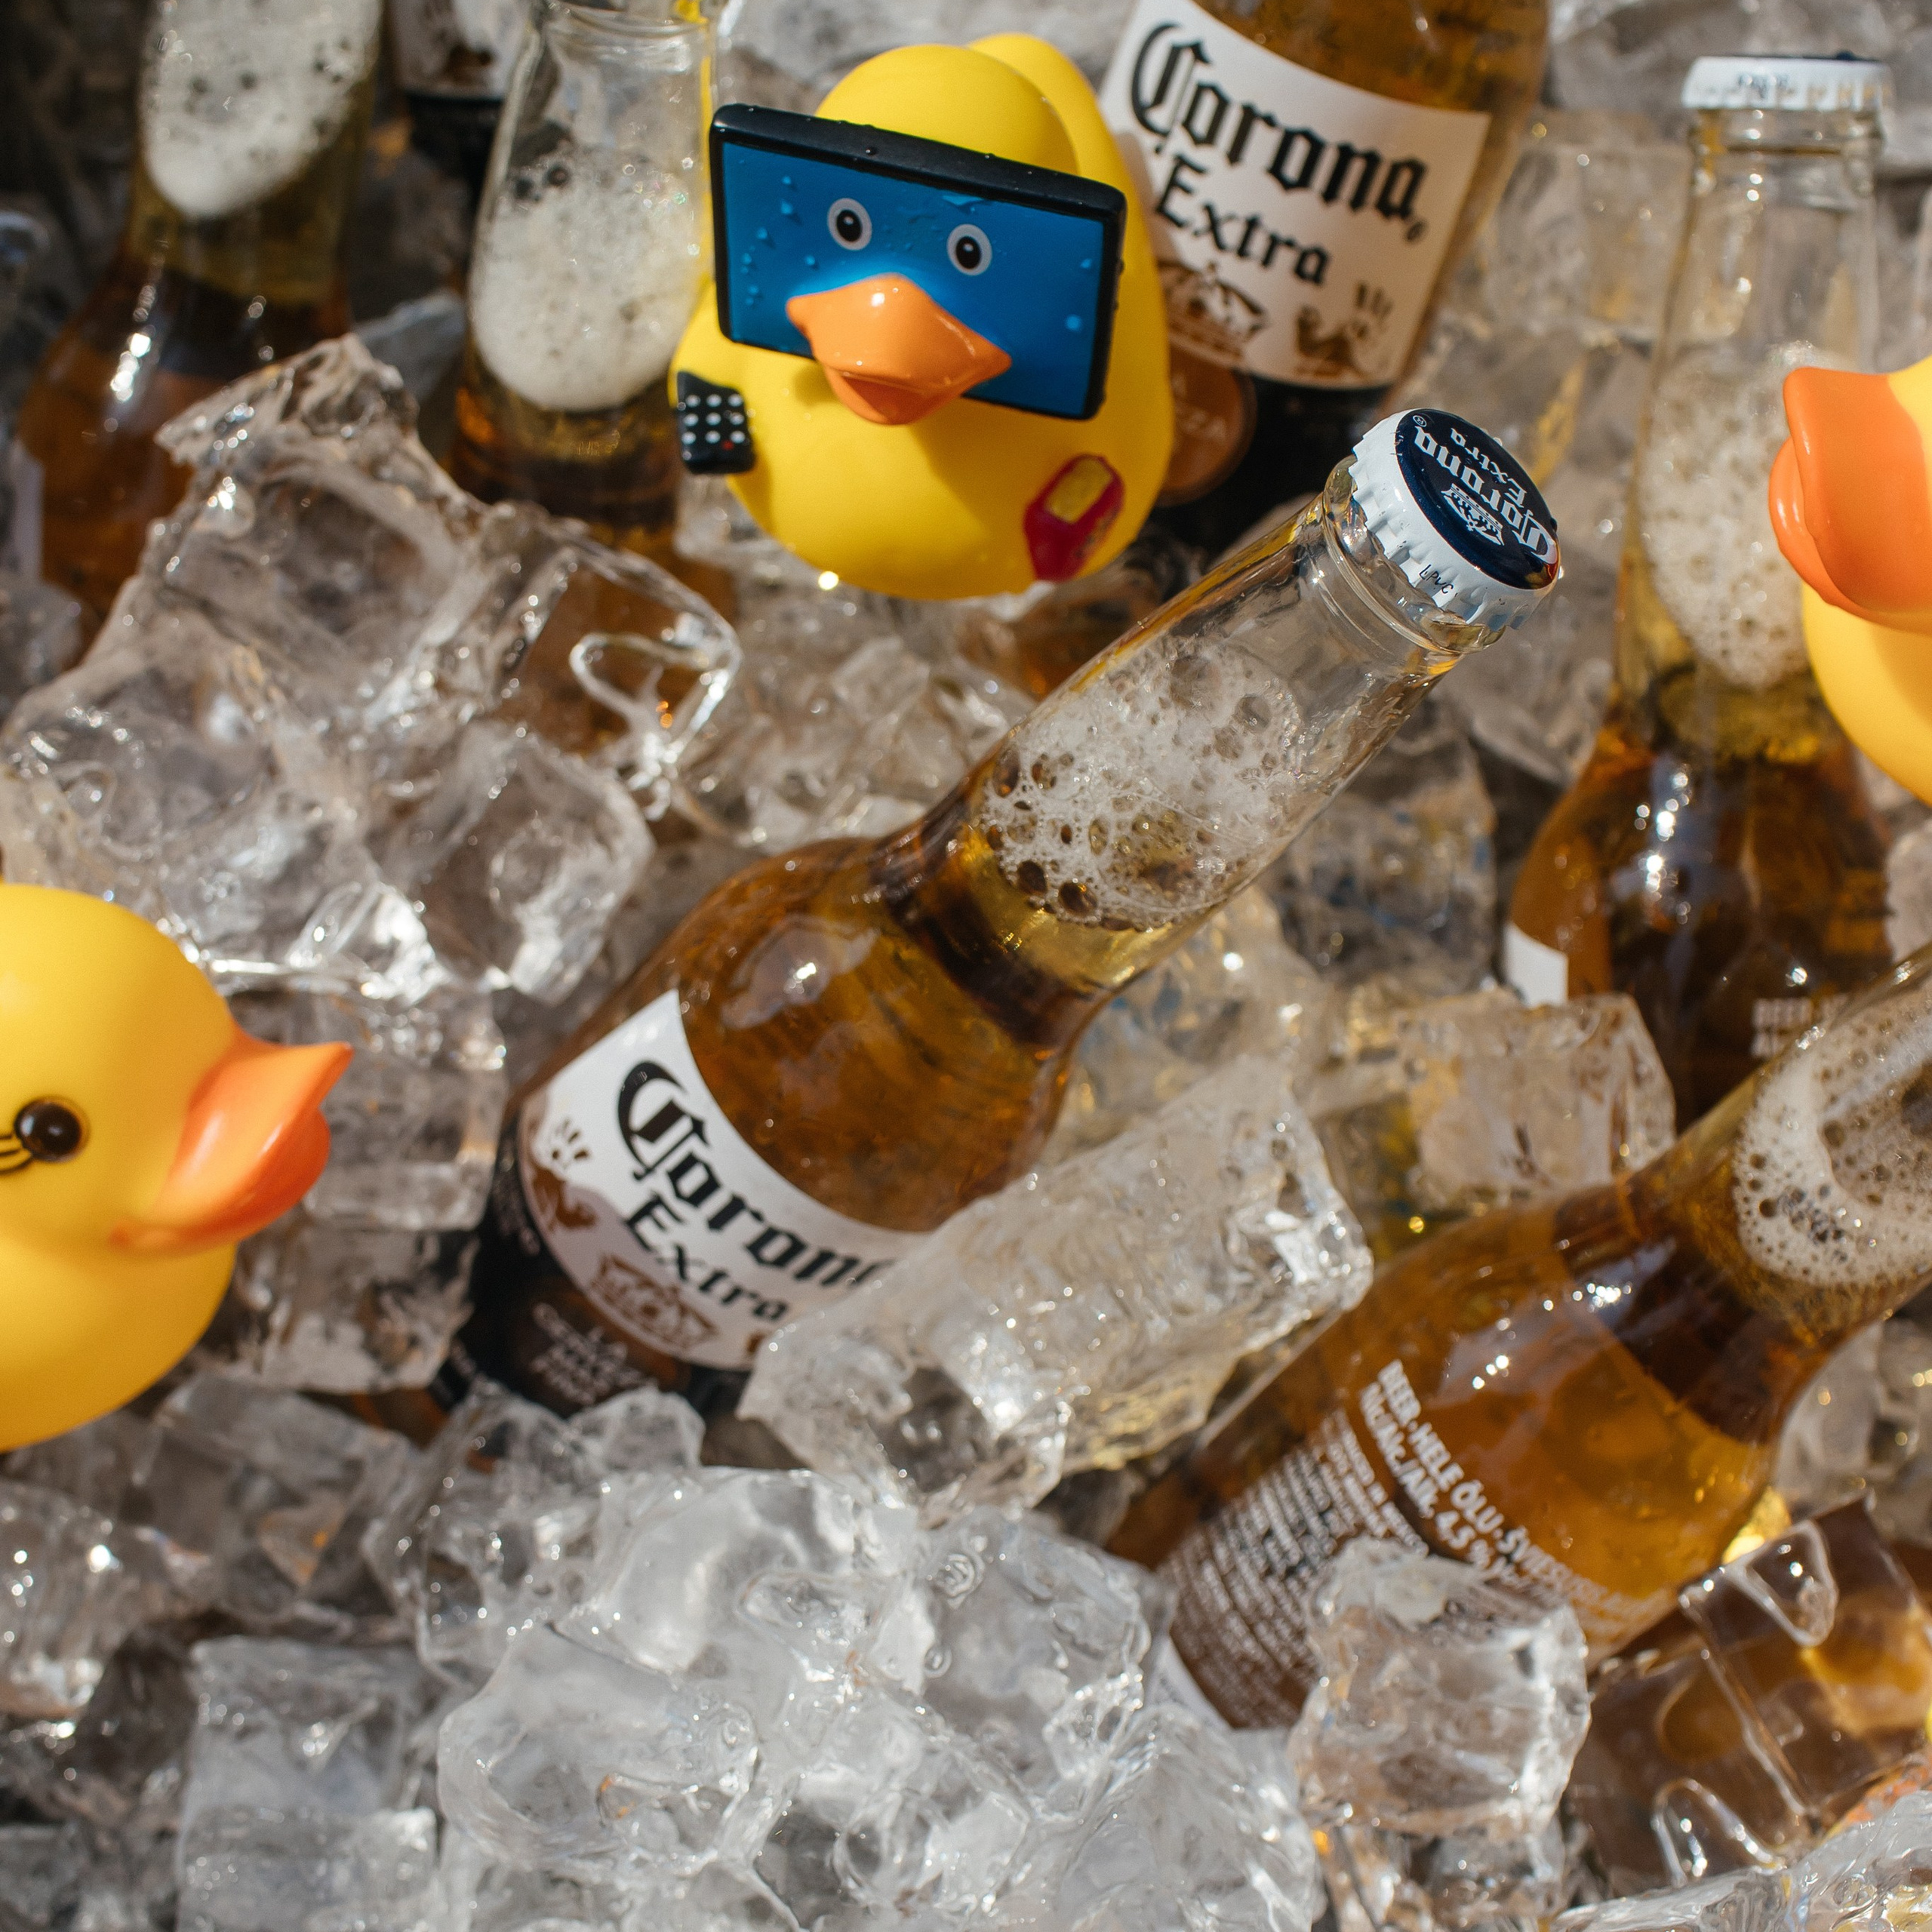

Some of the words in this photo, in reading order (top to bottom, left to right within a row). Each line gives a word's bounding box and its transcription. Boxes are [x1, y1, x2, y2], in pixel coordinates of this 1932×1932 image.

[1130, 21, 1429, 223] Corona
[1155, 153, 1334, 286] Extra
[1414, 425, 1559, 565] Corona
[1450, 427, 1527, 508] Extra
[623, 1189, 788, 1321] Extra
